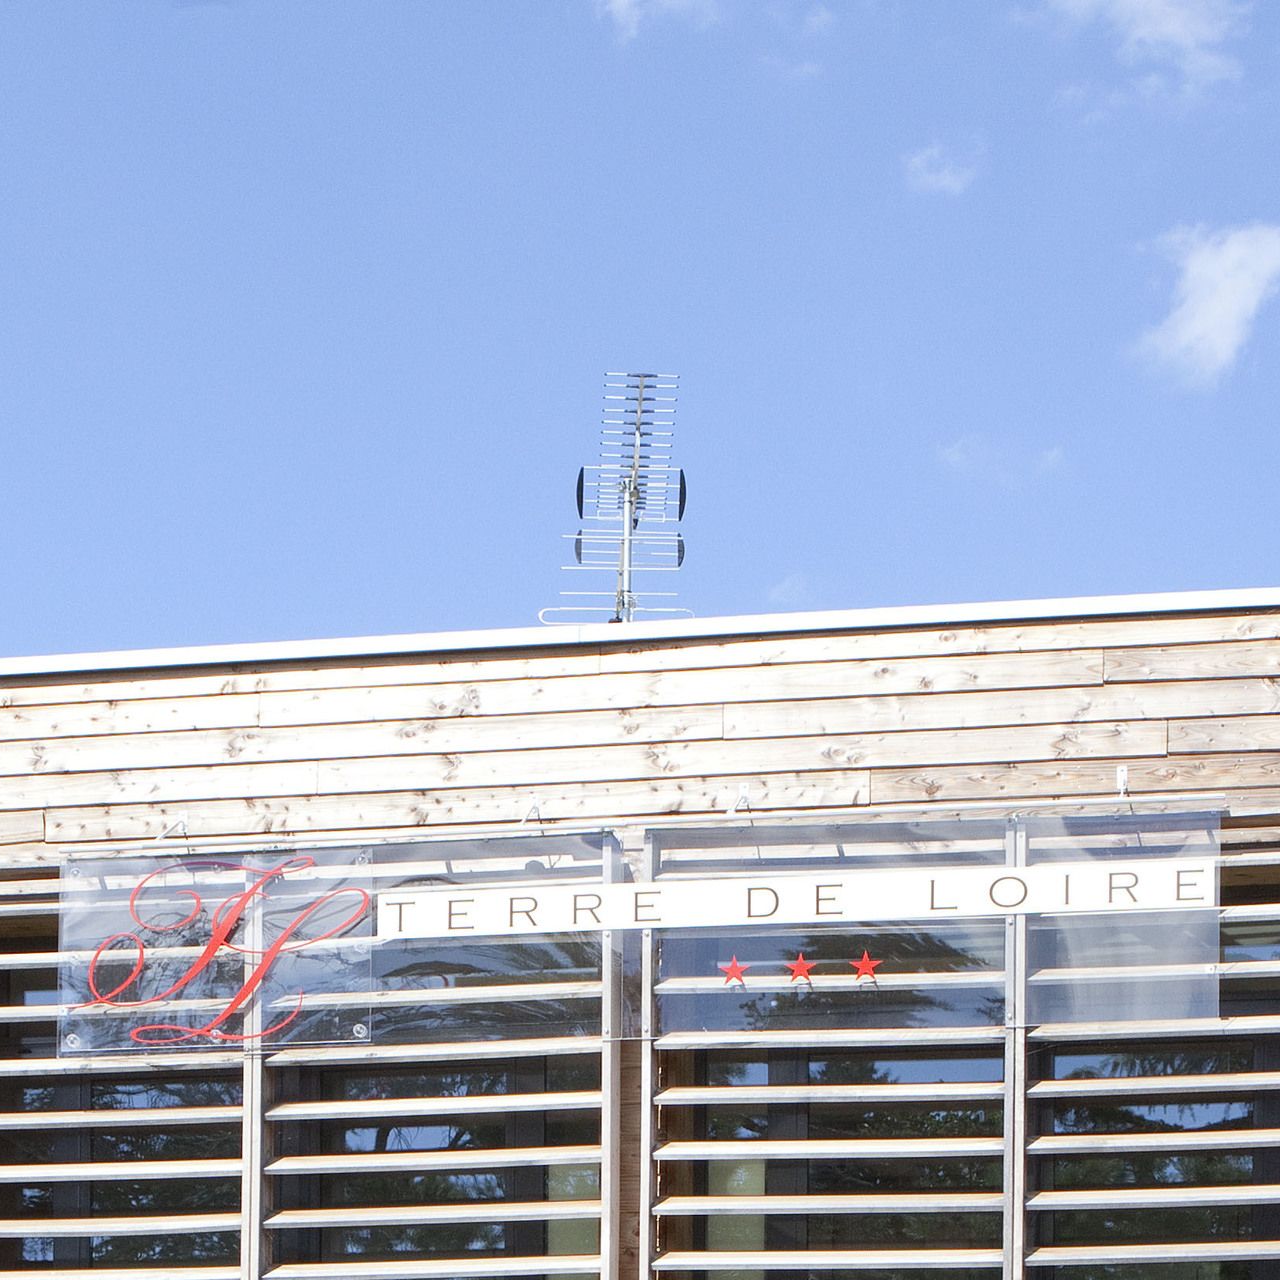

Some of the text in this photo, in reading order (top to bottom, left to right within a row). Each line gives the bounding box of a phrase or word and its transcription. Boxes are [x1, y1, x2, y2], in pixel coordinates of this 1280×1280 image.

[386, 869, 1205, 932] TERRE DE LOIRE
